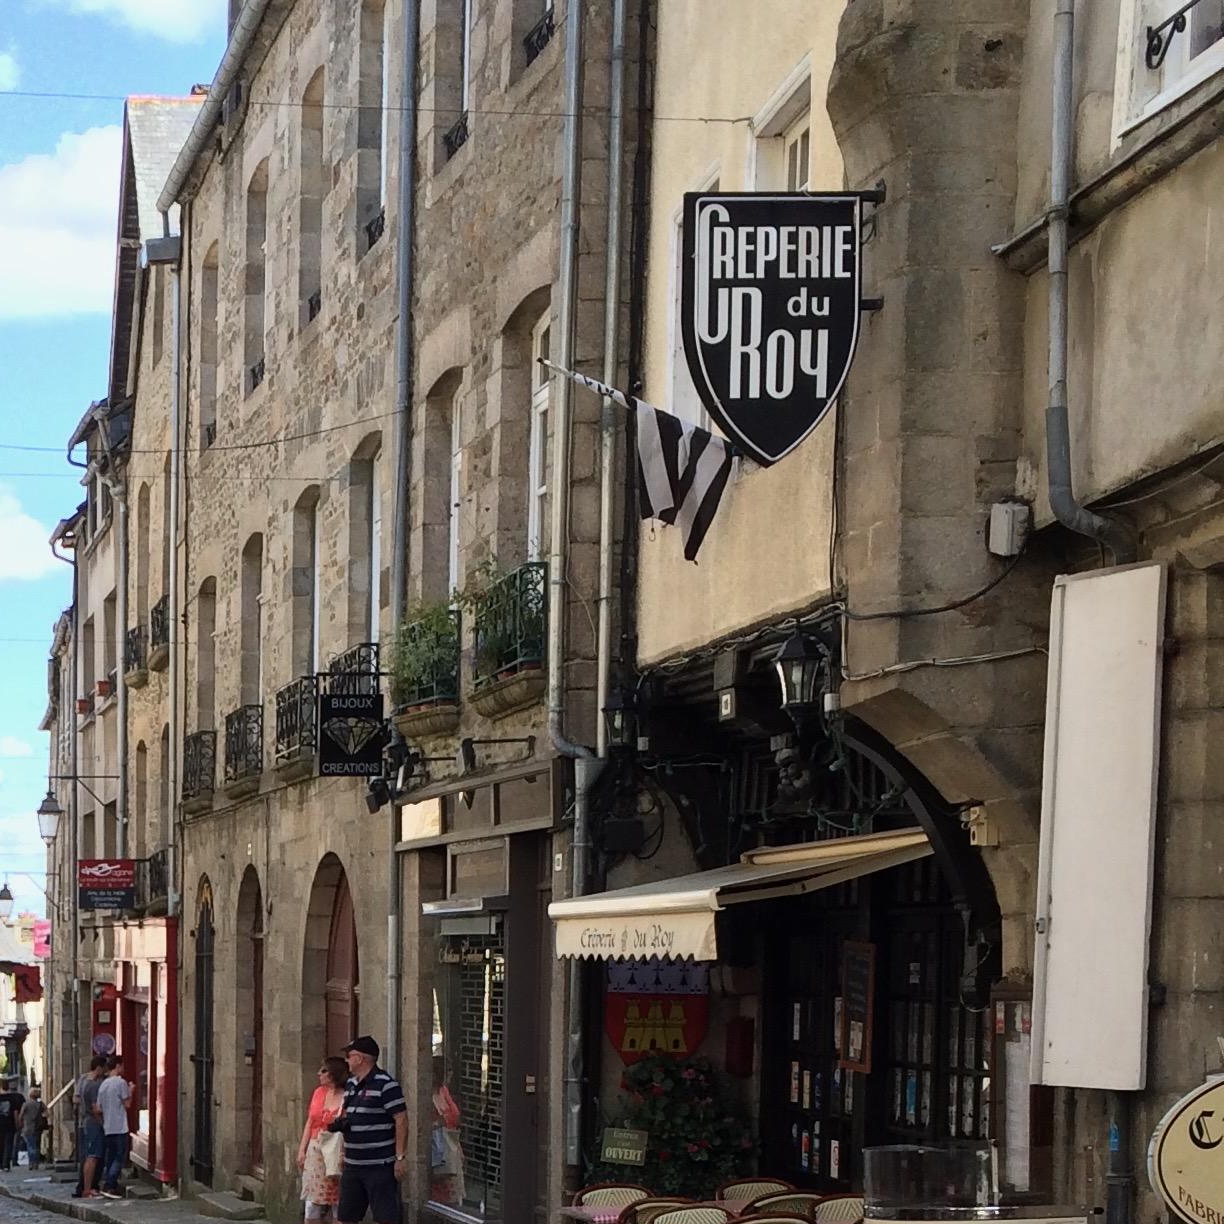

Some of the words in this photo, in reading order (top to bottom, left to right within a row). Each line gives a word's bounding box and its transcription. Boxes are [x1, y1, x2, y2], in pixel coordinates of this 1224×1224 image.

[697, 204, 852, 344] CREPERIE
[787, 287, 830, 316] du
[729, 287, 829, 399] Roy
[331, 698, 373, 709] BIJOUX
[322, 763, 379, 773] CREATIONS
[633, 928, 646, 949] du
[651, 924, 674, 953] Roy
